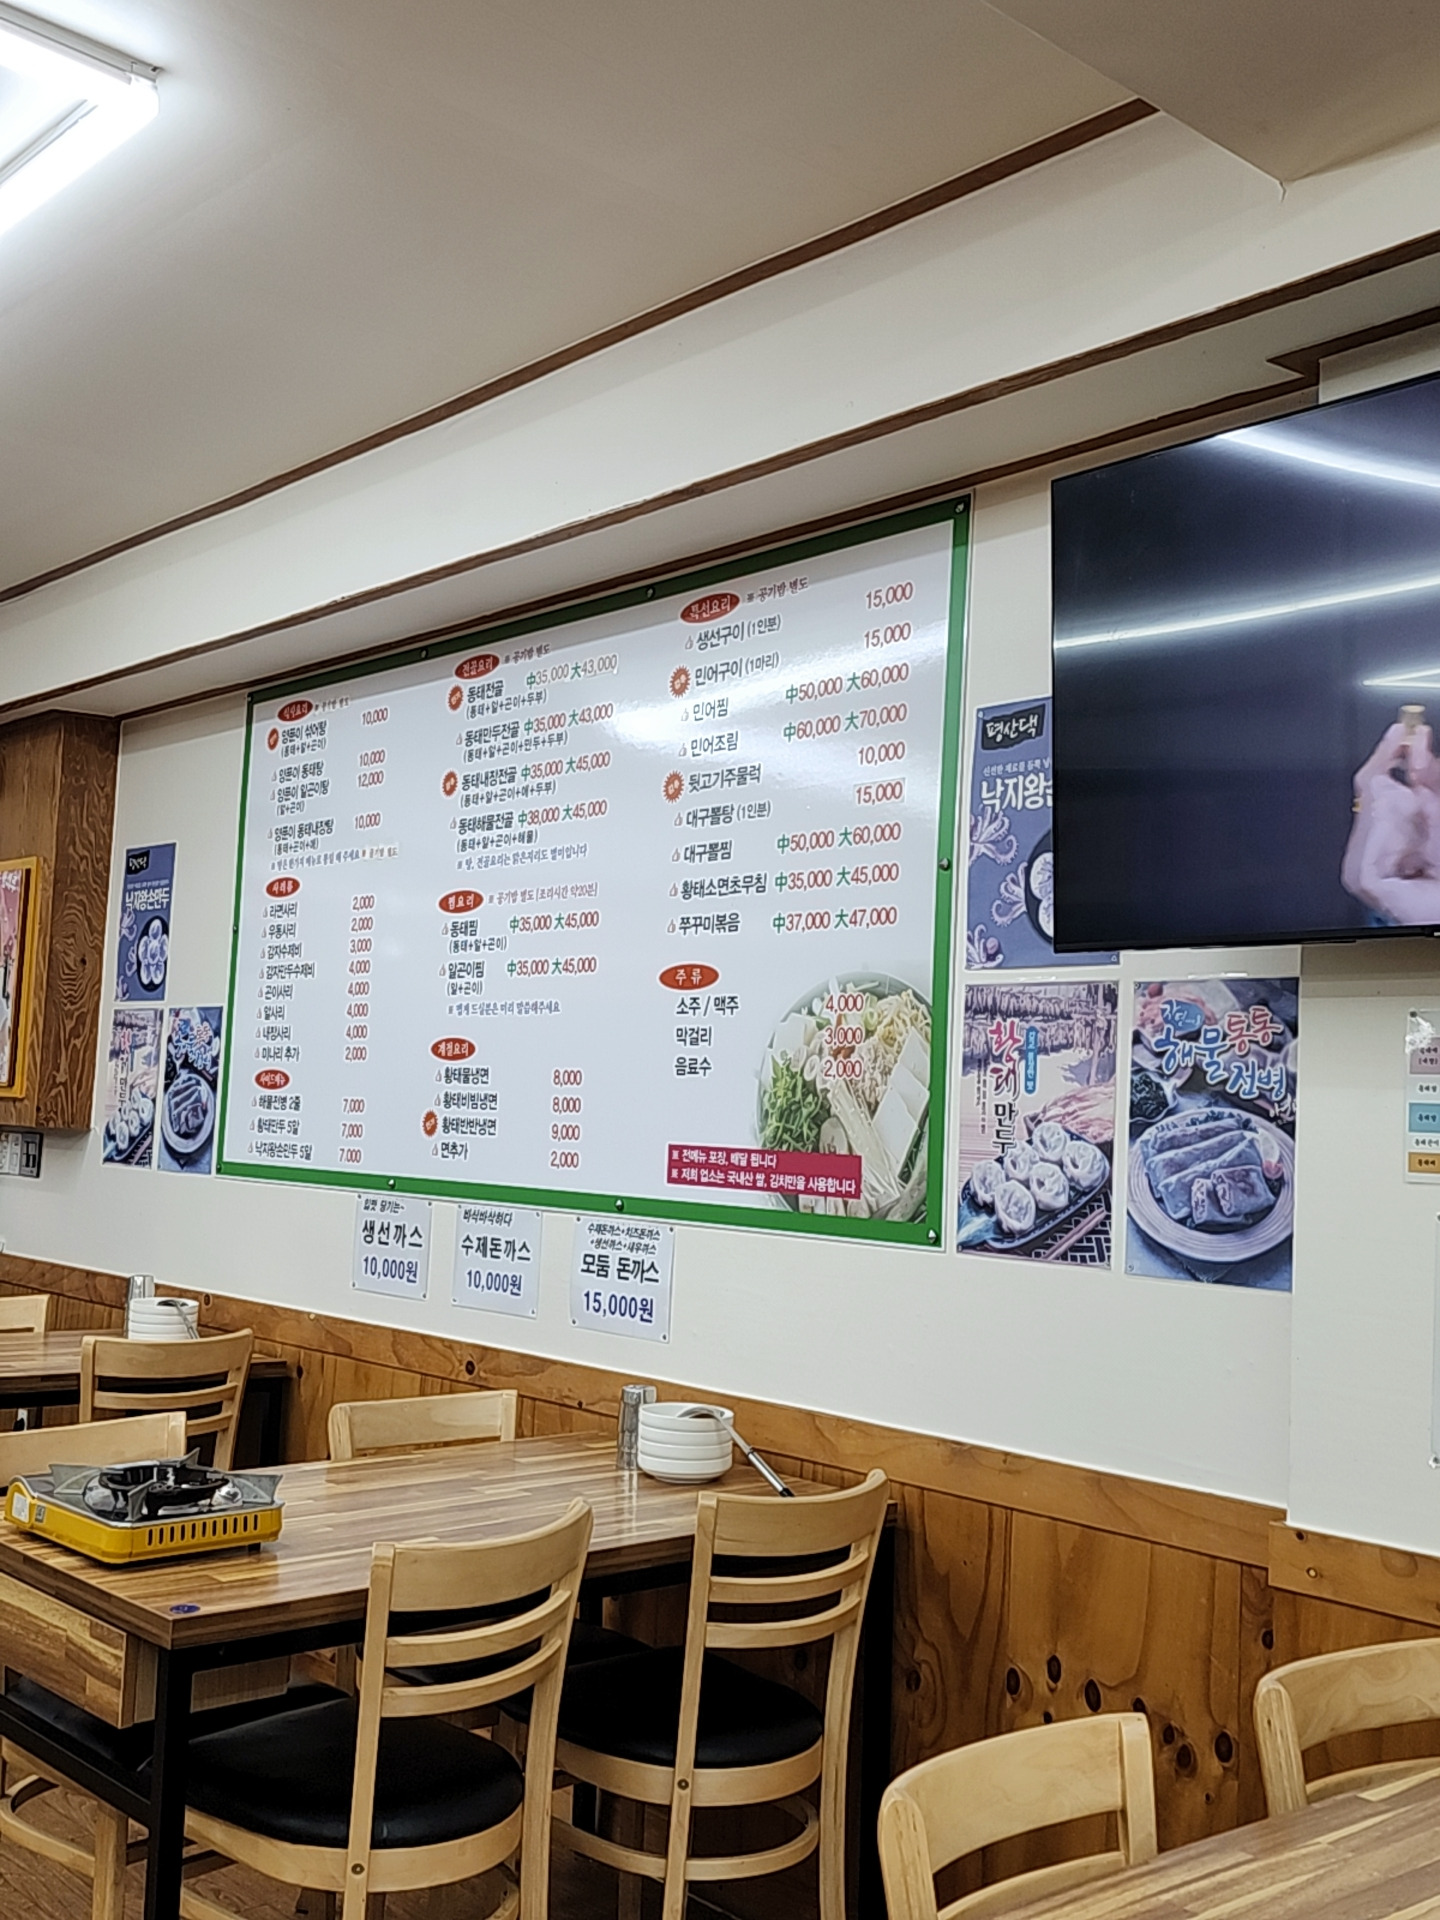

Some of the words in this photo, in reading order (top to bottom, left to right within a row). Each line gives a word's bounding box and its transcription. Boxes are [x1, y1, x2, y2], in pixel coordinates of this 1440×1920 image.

[757, 584, 787, 603] 공기밥
[789, 576, 809, 595] 별도
[695, 621, 745, 651] 생선구이
[747, 614, 781, 637] (1인분)
[866, 581, 914, 609] 15,000
[694, 659, 743, 687] 민어구이
[745, 652, 780, 676] (1마리)
[864, 622, 912, 649] 15,000
[467, 680, 504, 704] 동태전골
[693, 697, 729, 722] 민어찜
[786, 677, 843, 705] 中50,000
[846, 662, 909, 693] 大60,000
[362, 707, 388, 725] 10,000
[464, 721, 520, 748] 동태만두전골
[524, 712, 567, 735] 中35,000
[568, 703, 614, 727] 大43,000
[690, 731, 739, 757] 민어조림
[783, 715, 841, 742] 中60,000
[843, 703, 908, 732] 大70,000
[360, 749, 385, 767] 10,000
[462, 766, 517, 791] 동태내장전골
[521, 760, 564, 782] 中35,000
[565, 751, 611, 774] 大45,000
[688, 763, 762, 794] 뒷고기주물럭
[858, 741, 906, 766] 10,000
[357, 770, 384, 788] 12,000
[458, 811, 514, 835] 동태해물전골
[562, 800, 608, 822] 大45,000
[686, 803, 735, 829] 대구뽈탕
[736, 800, 772, 822] (1인분)
[856, 781, 903, 806] 15,000
[355, 812, 381, 829] 10,000
[683, 840, 732, 864] 대구뽈찜
[777, 830, 835, 854] 中50,000
[838, 822, 901, 848] 大60,000
[680, 872, 767, 901] 황태소면초무침
[774, 869, 833, 893] 中35,000
[836, 863, 900, 887] 大45,000
[352, 895, 375, 912] 2,000
[268, 922, 296, 940] 우동사리
[351, 916, 374, 933] 2,000
[450, 919, 479, 938] 동태찜
[510, 915, 552, 934] 中35,000
[554, 911, 600, 930] 大45,000
[678, 912, 741, 936] 쭈꾸미볶음
[772, 911, 831, 934] 中37,000
[834, 906, 898, 929] 大47,000
[267, 942, 302, 960] 감자수제비
[349, 938, 373, 955] 3,000
[348, 959, 371, 976] 4,000
[507, 959, 550, 977] 中35,000
[551, 956, 597, 975] 大45,000
[347, 981, 370, 997] 4,000
[346, 1003, 369, 1019] 4,000
[676, 996, 702, 1017] 소주
[713, 996, 740, 1017] 맥주
[825, 994, 865, 1013] 4,000
[345, 1024, 368, 1040] 4,000
[676, 1026, 713, 1047] 막걸리
[824, 1027, 863, 1046] 3,000
[345, 1046, 367, 1062] 2,000
[1154, 1026, 1228, 1082] 해물
[444, 1066, 490, 1085] 황태물냉면
[553, 1069, 583, 1087] 8,000
[674, 1057, 712, 1077] 음료수
[823, 1060, 862, 1079] 2,000
[1228, 1060, 1284, 1099] 전병
[343, 1098, 365, 1114] 7,000
[443, 1091, 498, 1111] 황태비빔냉면
[552, 1096, 582, 1115] 8,000
[341, 1123, 363, 1139] 7,000
[441, 1116, 497, 1136] 황태반반냉면
[551, 1123, 581, 1142] 9,000
[992, 1102, 1015, 1154] 만두
[440, 1141, 469, 1160] 면추가
[550, 1150, 579, 1169] 2,000
[730, 1153, 748, 1167] 배달
[750, 1153, 777, 1169] 됩니다
[681, 1168, 698, 1182] 저희
[700, 1169, 726, 1184] 업소는
[727, 1171, 754, 1187] 국내산
[769, 1174, 806, 1190] 김치만을
[808, 1177, 856, 1194] 사용합니다
[362, 1219, 424, 1249] 생선까스
[461, 1234, 532, 1263] 수제돈까스
[363, 1256, 419, 1285] 10,000원
[580, 1253, 611, 1279] 모둠
[616, 1257, 660, 1284] 돈까스
[466, 1269, 523, 1297] 10,000원
[583, 1290, 654, 1324] 15,000원
